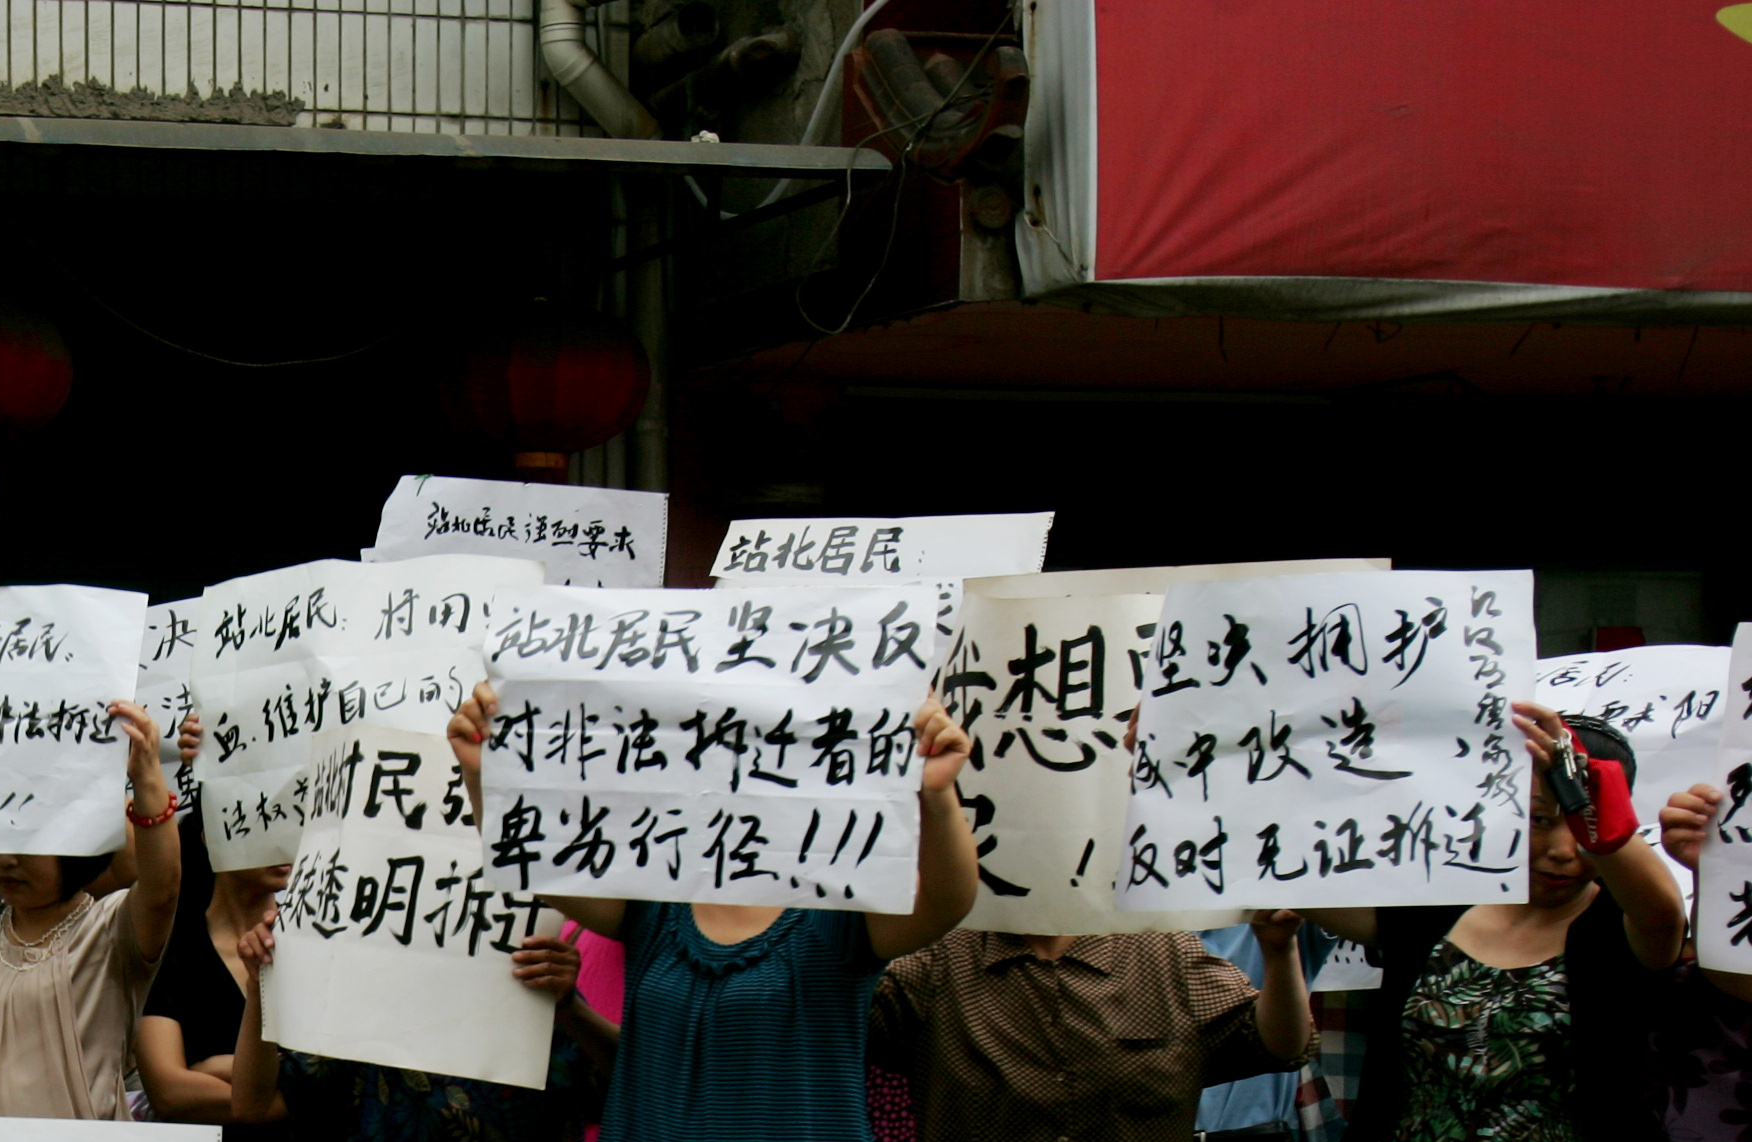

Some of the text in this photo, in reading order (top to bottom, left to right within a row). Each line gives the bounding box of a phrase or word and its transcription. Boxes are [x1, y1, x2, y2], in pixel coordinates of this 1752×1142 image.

[489, 599, 928, 683] 站北居民坚决反
[1151, 596, 1449, 698] 坚决拥护
[489, 700, 915, 792] 对非法拆迁者的
